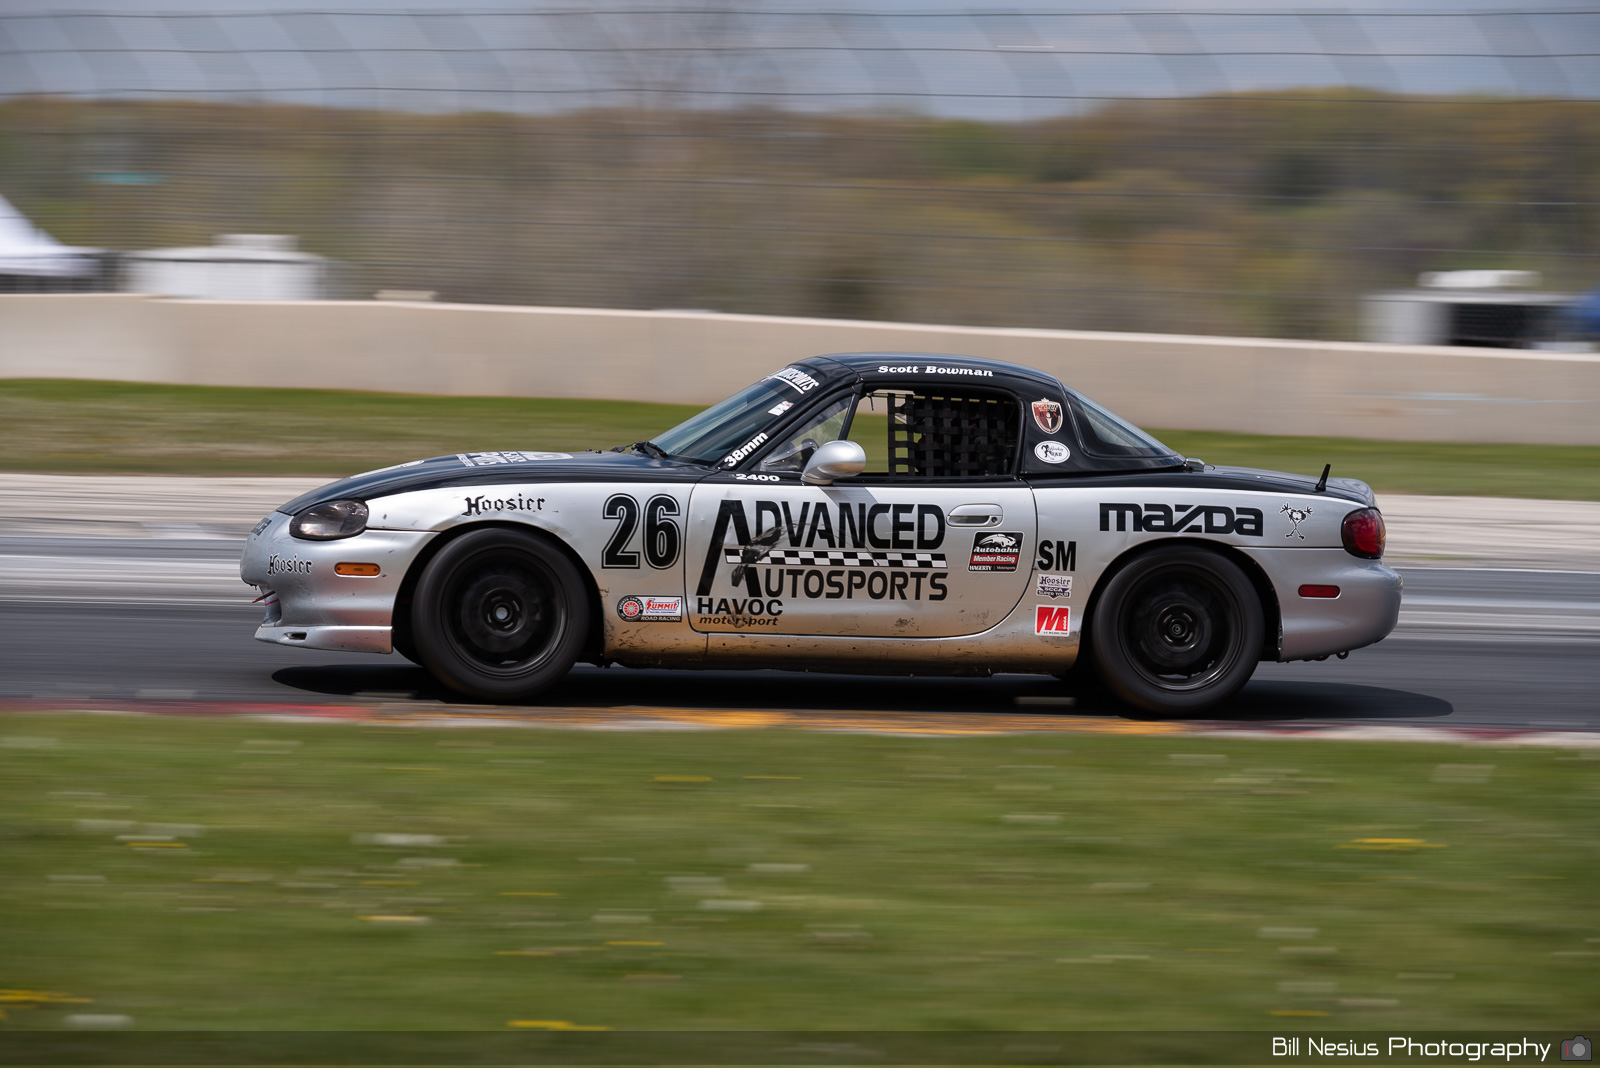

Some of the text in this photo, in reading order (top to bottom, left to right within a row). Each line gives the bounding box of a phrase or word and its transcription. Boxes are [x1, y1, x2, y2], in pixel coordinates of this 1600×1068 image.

[925, 366, 993, 377] Bowman
[724, 432, 768, 467] 38mm
[735, 473, 780, 482] 2400
[461, 493, 546, 516] Hoosier
[601, 493, 681, 570] 26
[696, 499, 946, 565] ADVANCED
[267, 553, 313, 576] Hoosier
[996, 555, 1016, 564] Racing
[1037, 539, 1077, 572] SM
[1039, 576, 1071, 585] Hoosier
[697, 597, 783, 616] HAVOC
[699, 614, 779, 627] motorsport
